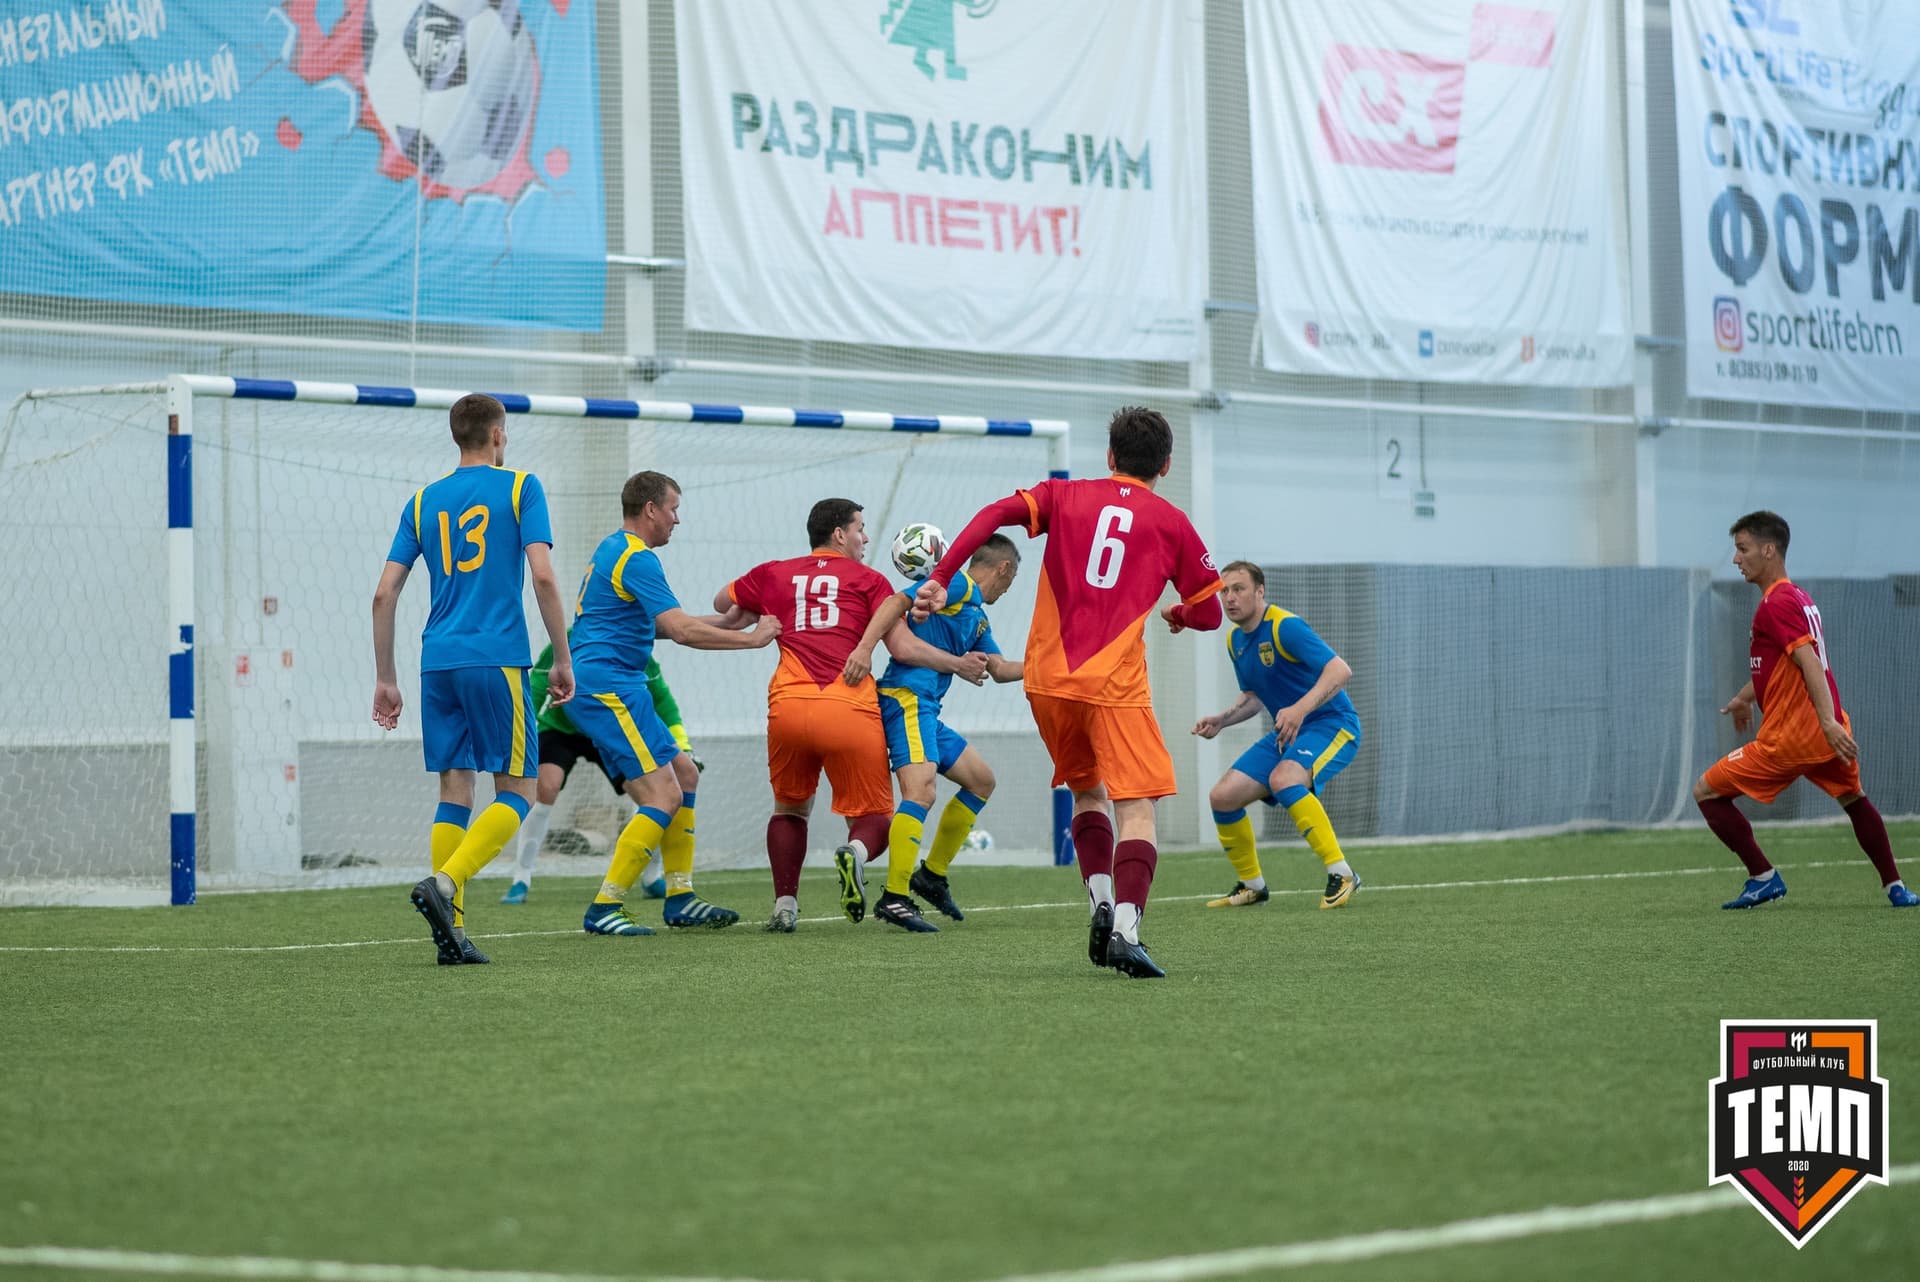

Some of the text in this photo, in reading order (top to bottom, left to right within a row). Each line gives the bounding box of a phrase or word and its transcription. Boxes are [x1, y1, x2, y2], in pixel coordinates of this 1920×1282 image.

[0, 0, 166, 67] НЕРАЛЬНЫЙ
[104, 146, 154, 200] ФК
[730, 91, 1152, 191] РАЗДРАКОНИМ
[823, 185, 1082, 257] АППЕТИТ!
[1745, 307, 1903, 357] sportlifebrn
[1386, 438, 1402, 479] 2
[437, 504, 490, 577] 13
[1085, 504, 1134, 589] 6
[792, 574, 840, 632] 13
